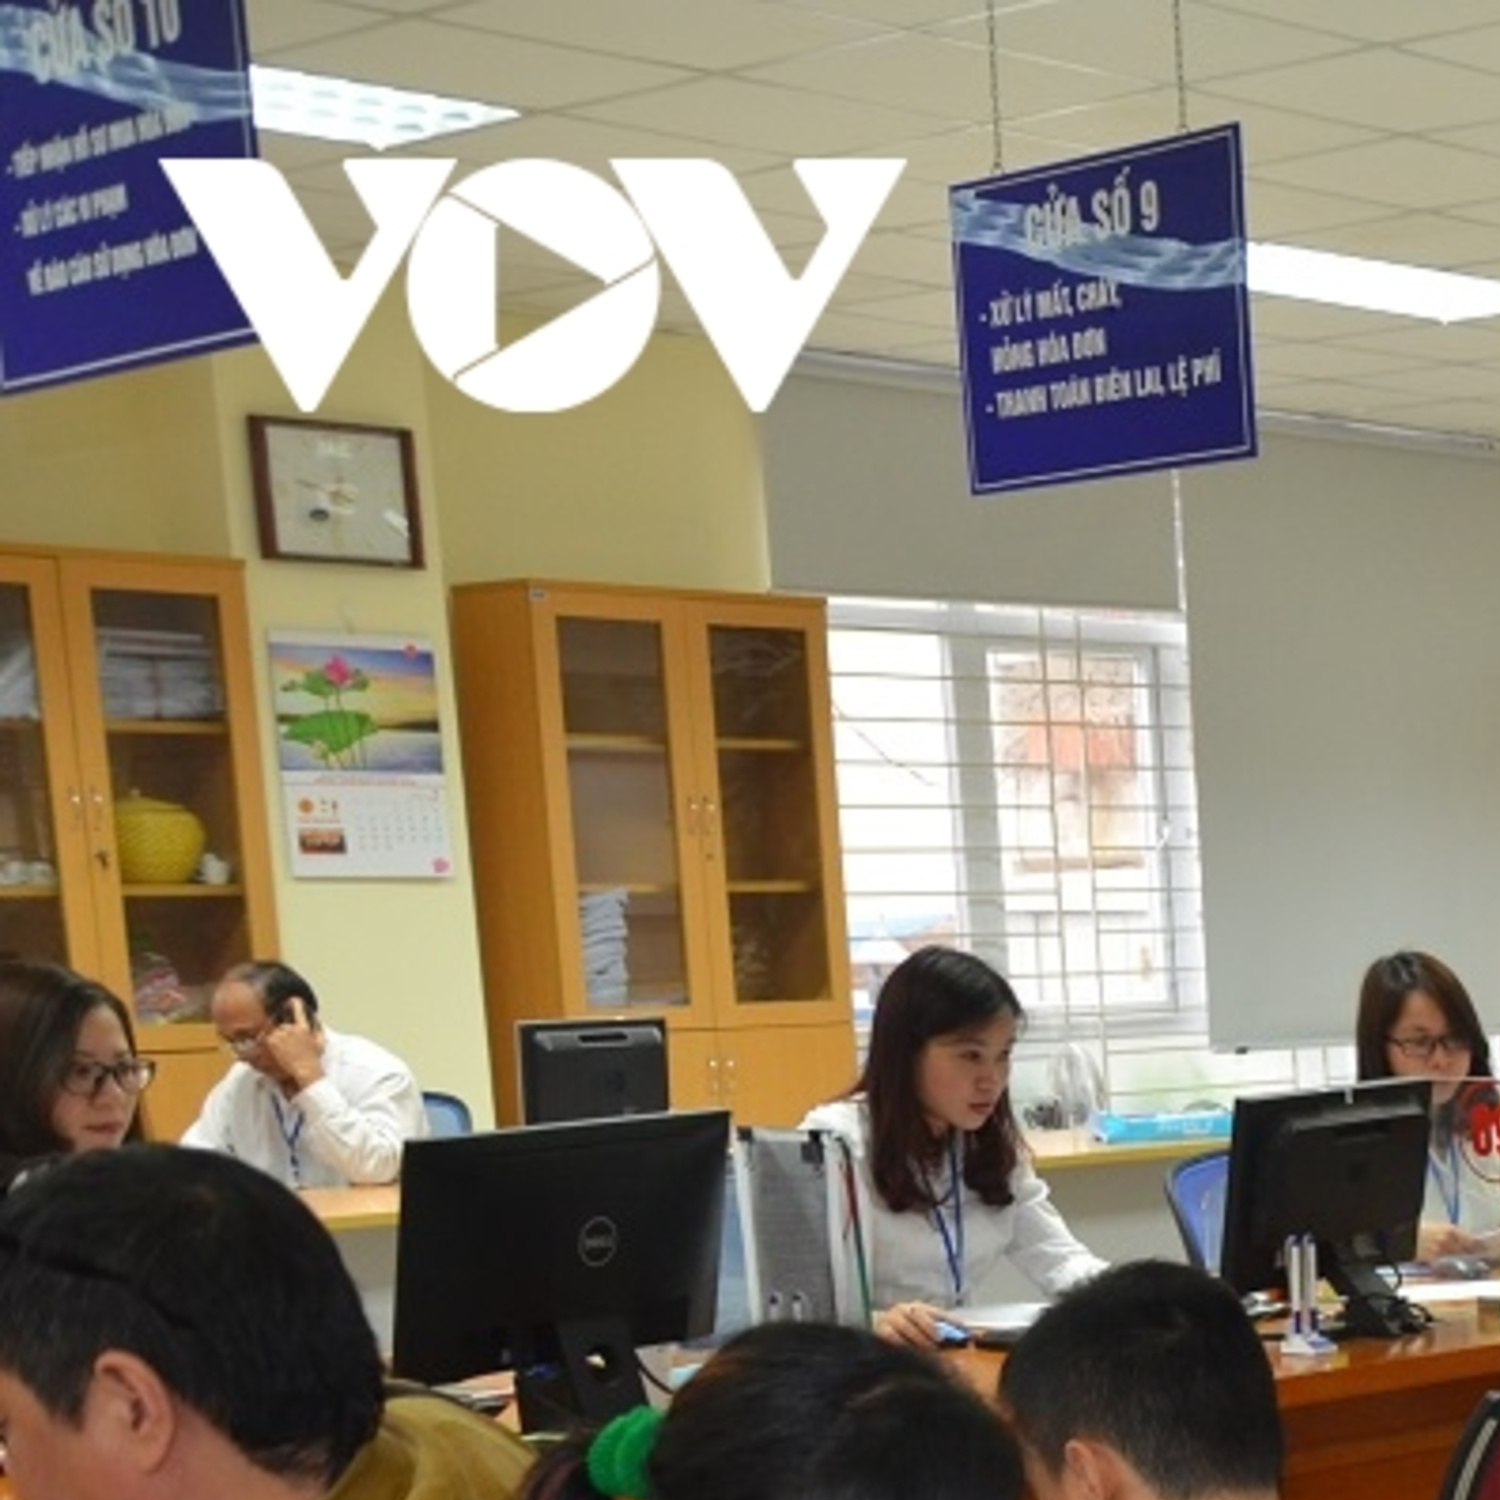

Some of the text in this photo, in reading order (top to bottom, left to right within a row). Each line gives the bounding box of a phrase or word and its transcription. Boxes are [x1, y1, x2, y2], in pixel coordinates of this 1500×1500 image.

[1024, 166, 1160, 252] CỬA SỐ 9
